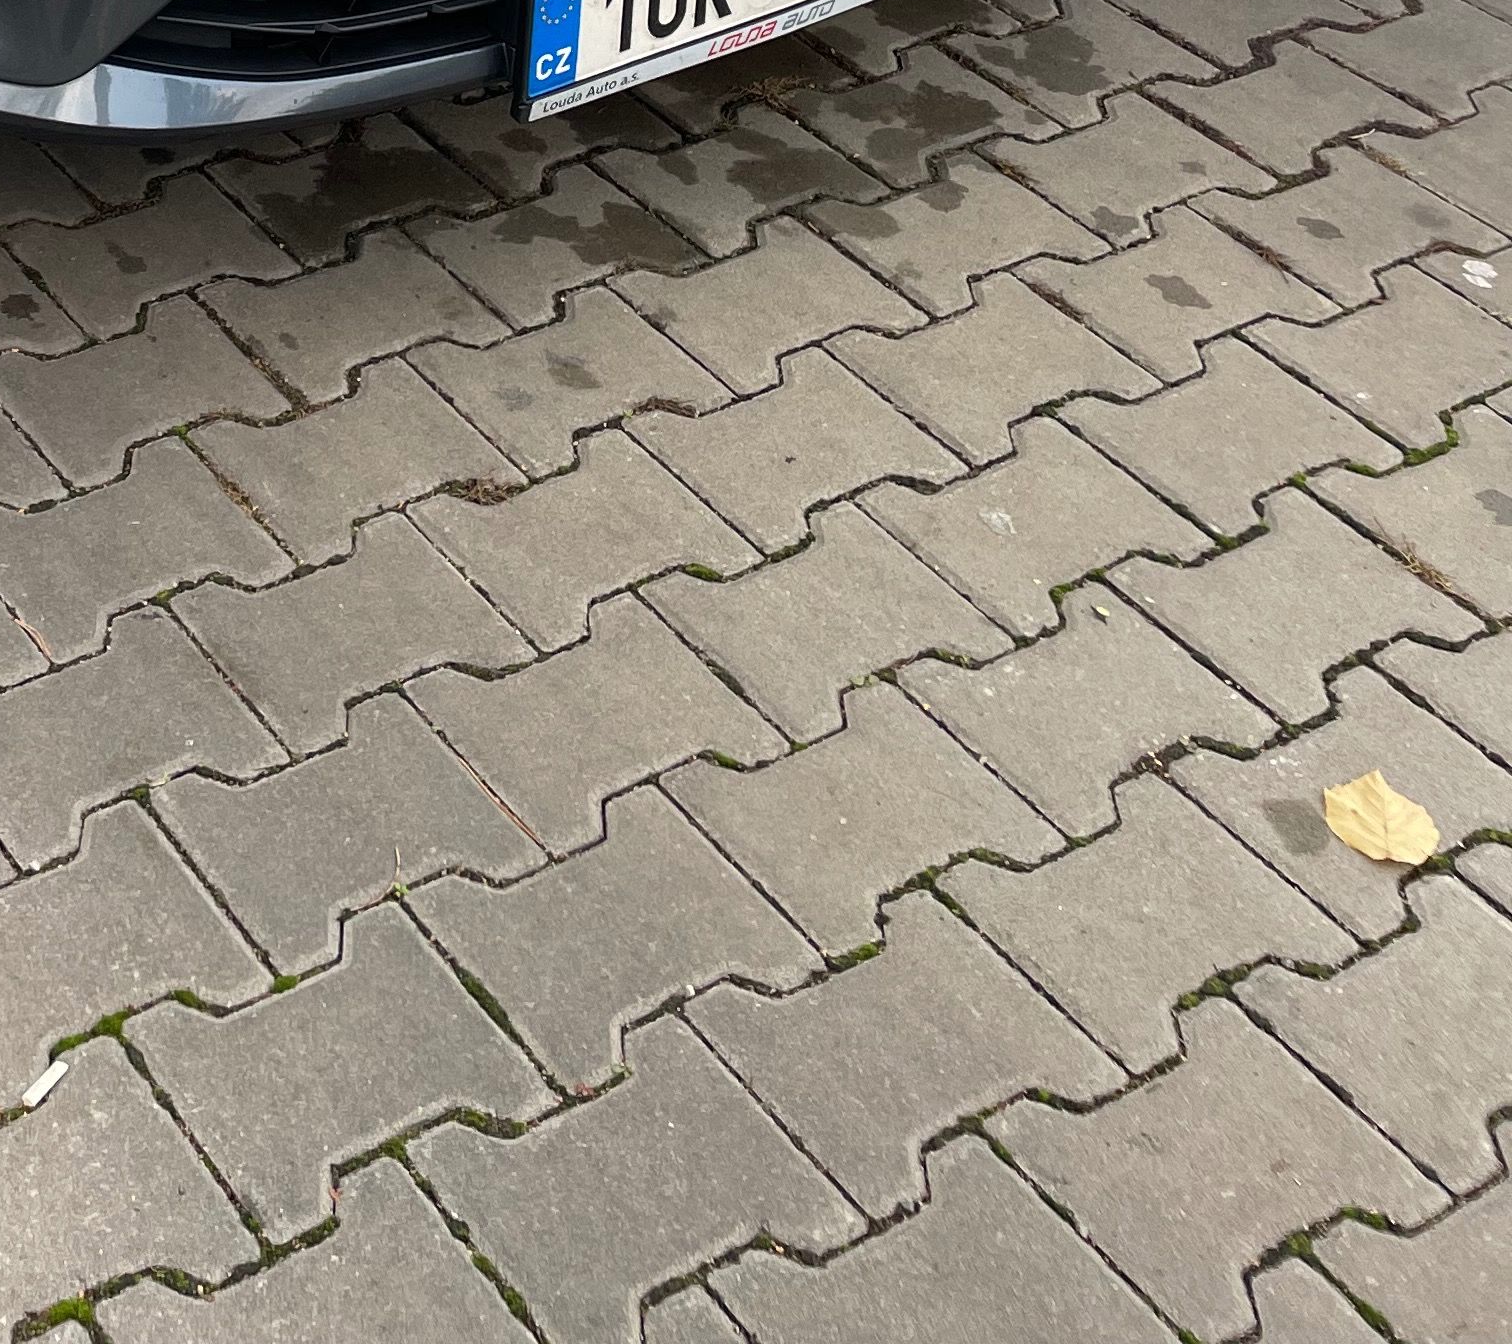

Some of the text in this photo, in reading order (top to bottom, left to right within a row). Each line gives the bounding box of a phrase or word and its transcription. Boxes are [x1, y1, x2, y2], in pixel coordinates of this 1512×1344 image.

[535, 46, 572, 81] CZ
[542, 91, 583, 113] Louda
[585, 78, 617, 99] Auto
